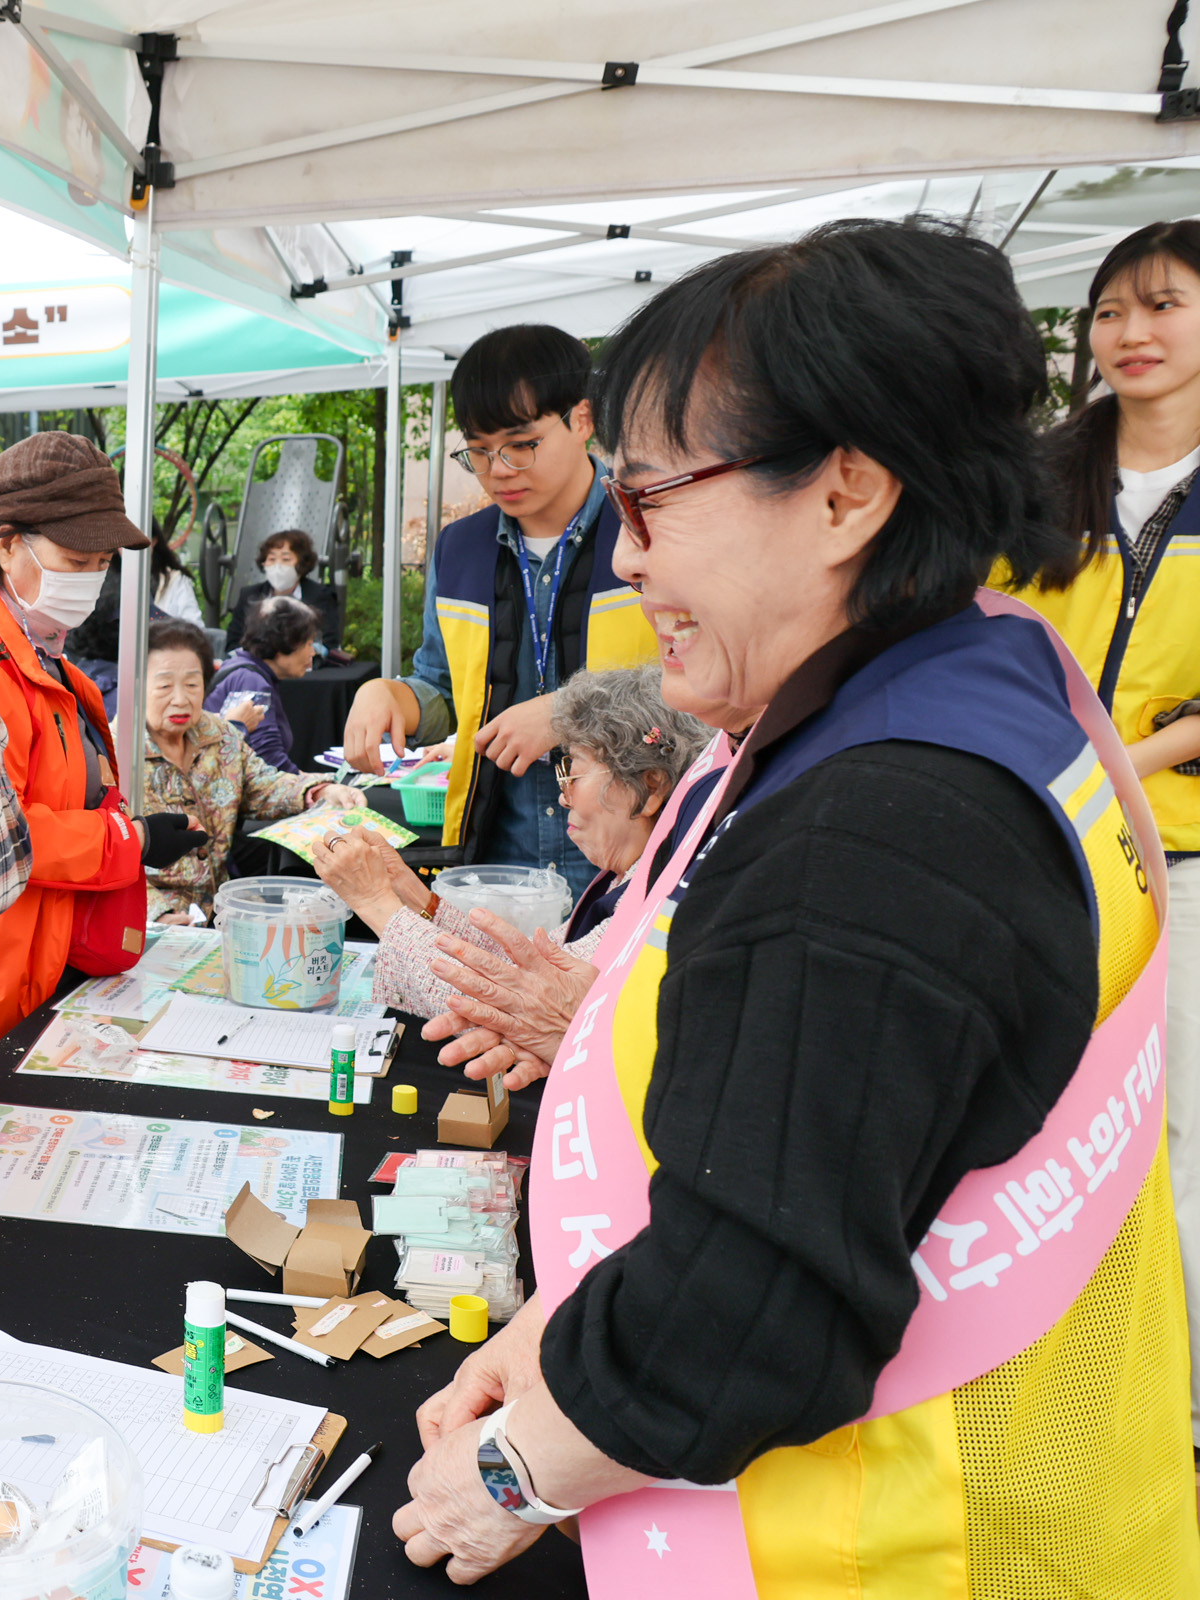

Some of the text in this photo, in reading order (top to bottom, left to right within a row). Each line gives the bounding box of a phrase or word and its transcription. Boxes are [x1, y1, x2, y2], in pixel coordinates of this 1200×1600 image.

[306, 965, 330, 976] 리스트
[311, 956, 328, 966] 버킷
[274, 1189, 296, 1209] 3가지
[252, 1550, 290, 1600] 사전연
[288, 1559, 326, 1600] OX
